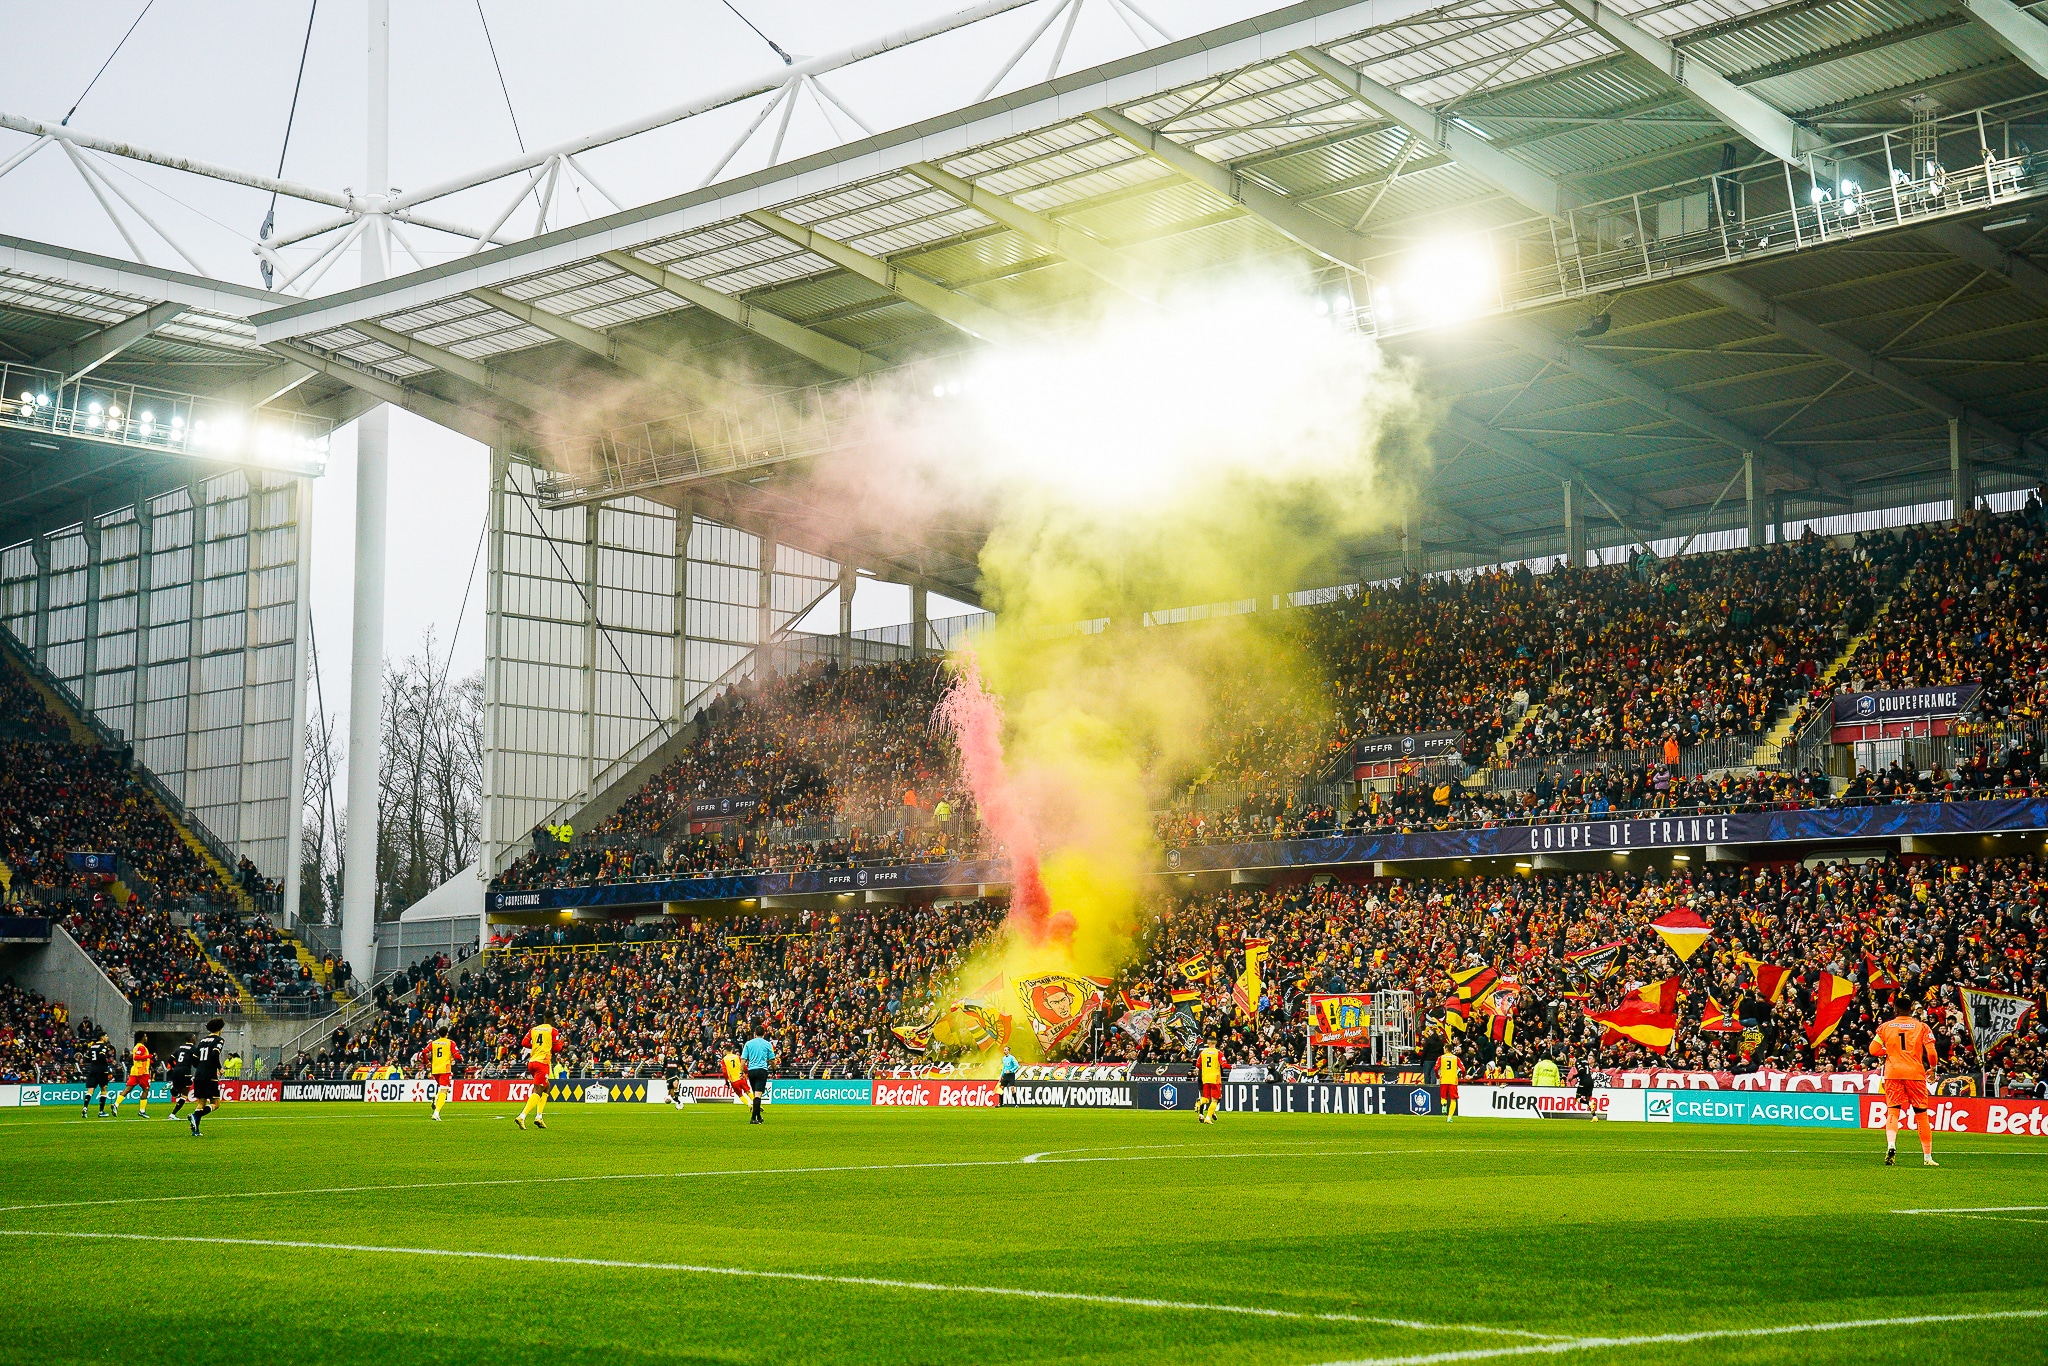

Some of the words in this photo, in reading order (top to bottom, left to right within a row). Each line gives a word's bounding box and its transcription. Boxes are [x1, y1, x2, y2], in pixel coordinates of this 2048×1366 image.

[1880, 695, 1910, 712] COUPE
[1919, 692, 1957, 708] FRANCE
[1364, 744, 1393, 753] FFF.FR
[1530, 825, 1591, 850] COUPE
[1609, 823, 1631, 846] DE
[1650, 818, 1729, 844] FRANCE
[536, 1033, 543, 1046] 4
[1898, 1033, 1906, 1051] 1
[91, 1050, 97, 1061] 3
[178, 1052, 185, 1063] 6
[200, 1047, 208, 1061] 11
[436, 1047, 443, 1058] 6
[1206, 1057, 1212, 1068] 2
[1446, 1060, 1452, 1070] 3
[240, 1083, 278, 1102] Betclic
[282, 1084, 363, 1102] NIKE.COM/FOOTBALL
[460, 1083, 492, 1101] KFC
[586, 1090, 607, 1101] Pasquier
[773, 1086, 812, 1100] CRÉDIT
[813, 1088, 870, 1100] AGRICOLE
[875, 1083, 930, 1106] Betclic
[938, 1084, 995, 1107] Betclic
[1272, 1084, 1295, 1113] DE
[1307, 1085, 1387, 1115] FRANCE
[1675, 1099, 1746, 1118] CRÉDIT
[1751, 1104, 1855, 1122] AGRICOLE
